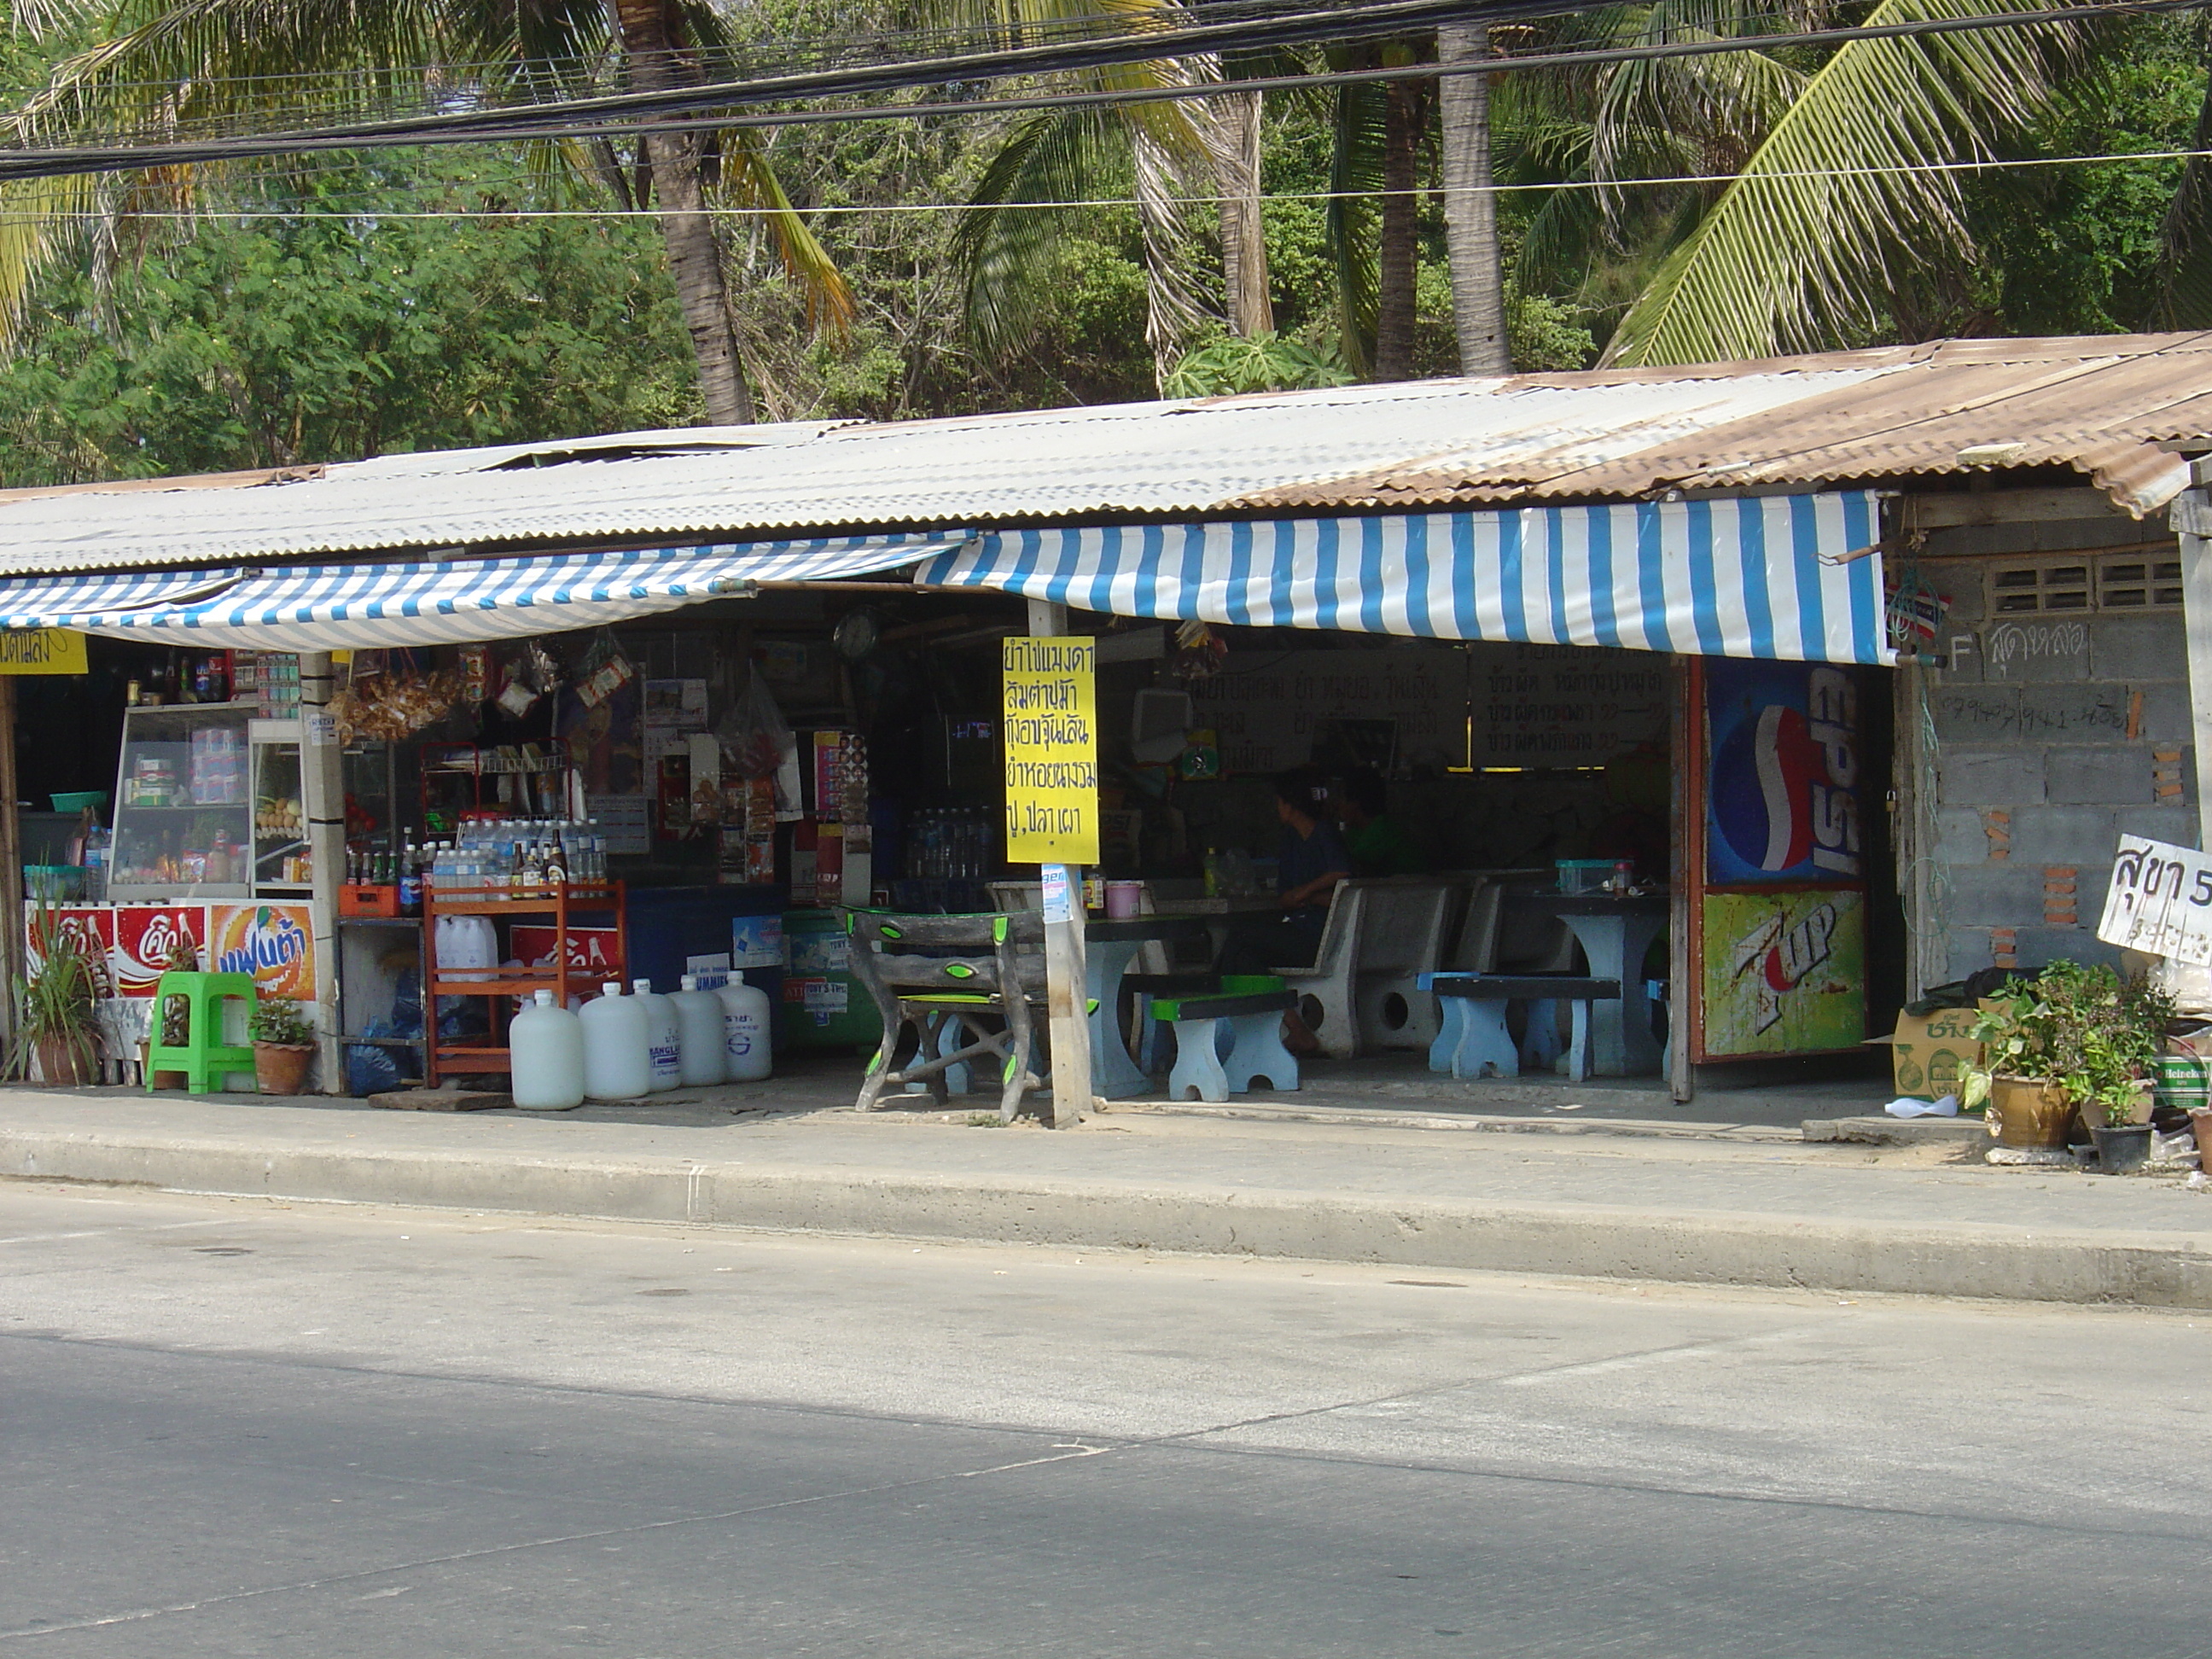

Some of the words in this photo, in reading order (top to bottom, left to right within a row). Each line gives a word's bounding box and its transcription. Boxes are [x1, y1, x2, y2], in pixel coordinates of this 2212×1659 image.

[1004, 638, 1094, 672] ยำไข่แมงดา
[1006, 678, 1077, 711] ส้มตำปูม้า
[1007, 756, 1097, 789] ยำหอยนางรม
[1809, 667, 1860, 876] EPSI
[2116, 845, 2185, 910] สุขา
[2189, 869, 2212, 907] 5
